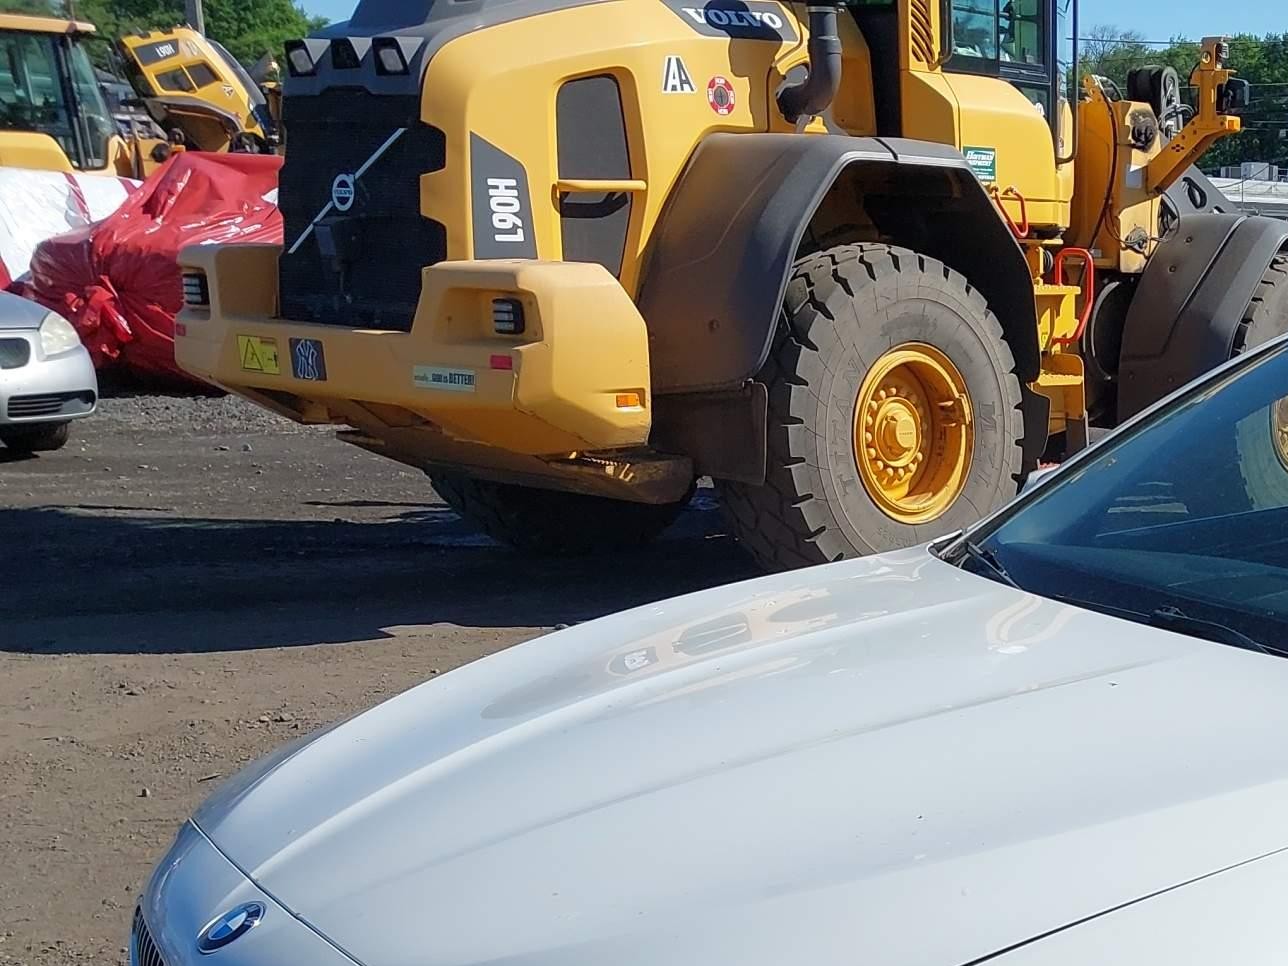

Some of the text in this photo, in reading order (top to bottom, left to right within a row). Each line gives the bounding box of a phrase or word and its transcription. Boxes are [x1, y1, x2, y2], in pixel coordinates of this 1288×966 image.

[681, 7, 783, 29] VOLVO
[154, 42, 176, 59] L90H
[486, 178, 525, 242] L90H
